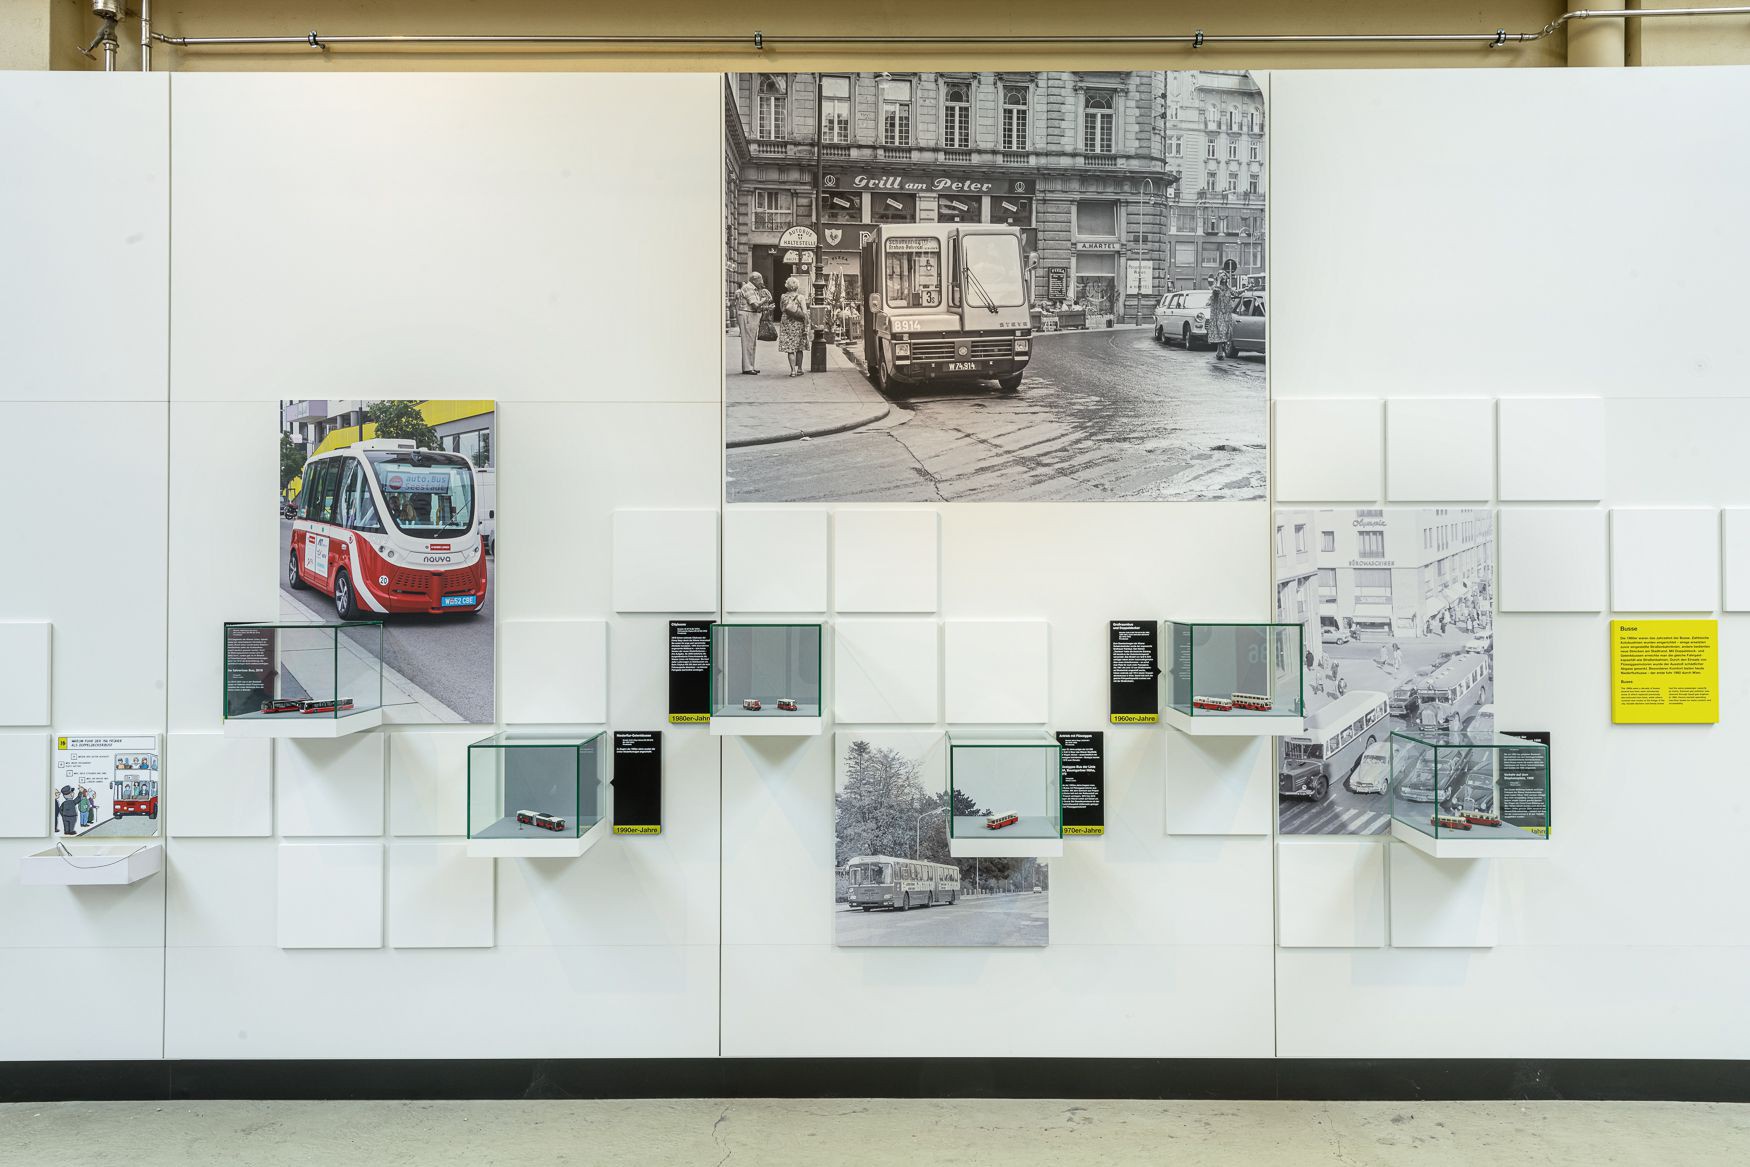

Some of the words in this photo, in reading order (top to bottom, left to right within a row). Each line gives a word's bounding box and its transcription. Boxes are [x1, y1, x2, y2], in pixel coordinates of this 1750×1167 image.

[853, 175, 901, 190] Grill
[905, 181, 926, 190] am
[931, 177, 992, 192] Peter
[788, 228, 813, 238] AUTOBUS
[894, 320, 921, 331] 8914
